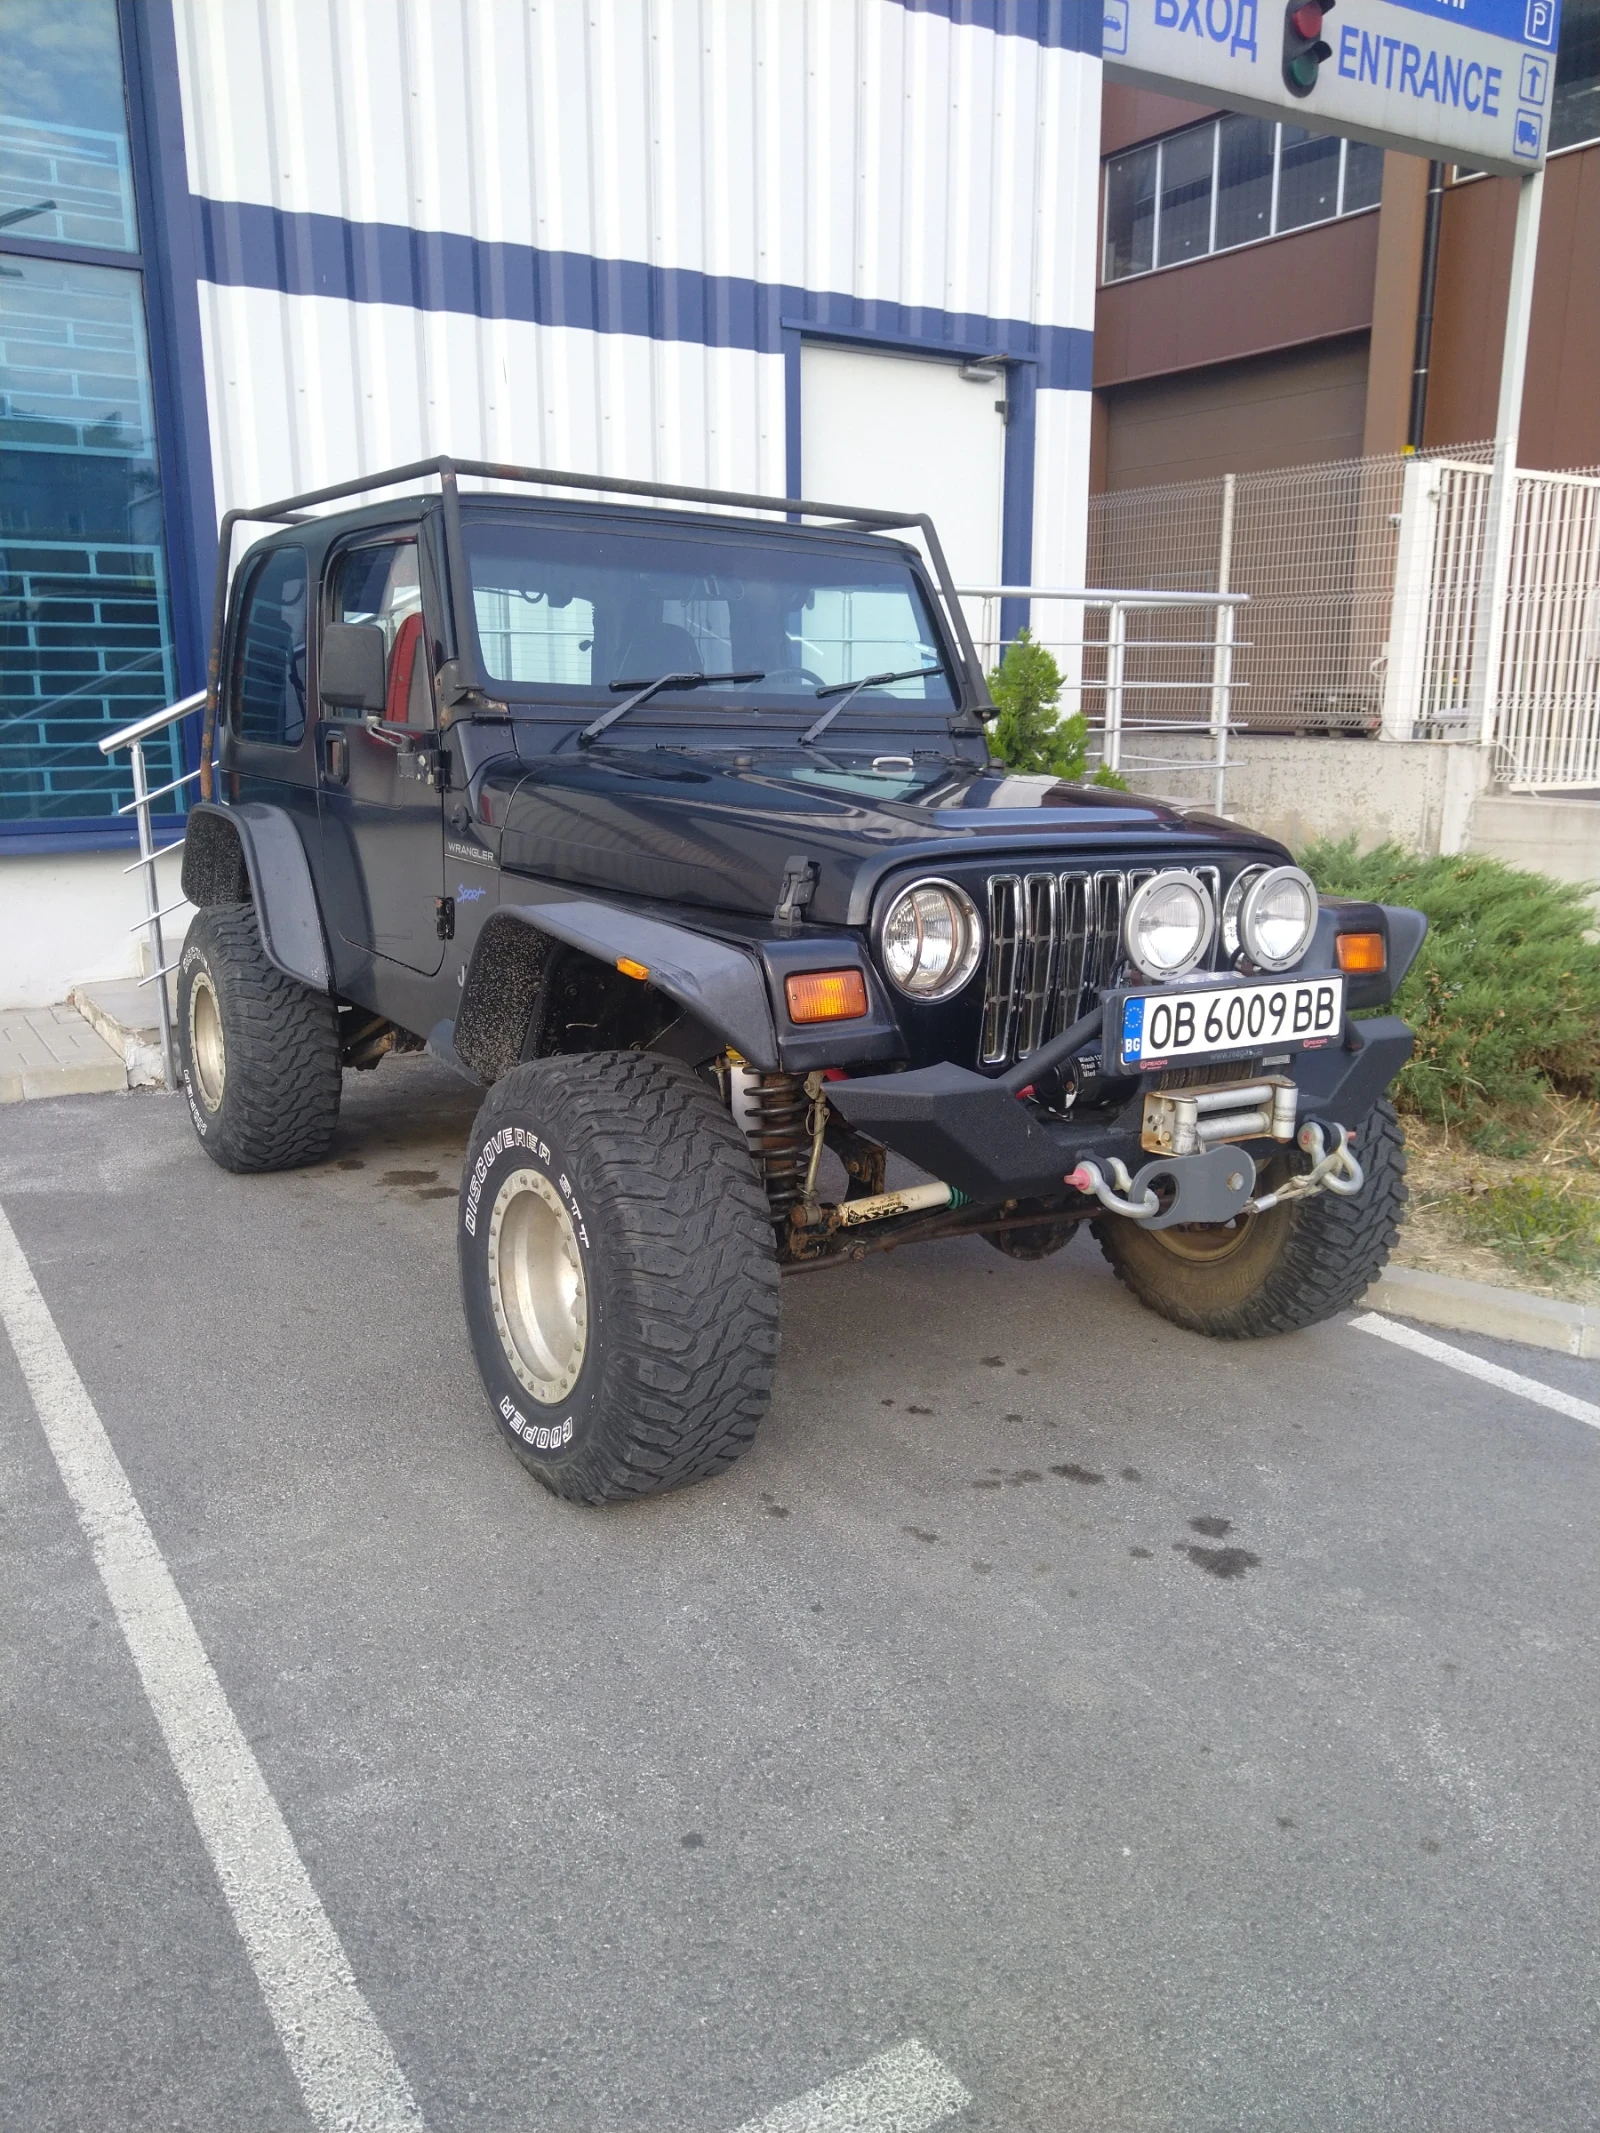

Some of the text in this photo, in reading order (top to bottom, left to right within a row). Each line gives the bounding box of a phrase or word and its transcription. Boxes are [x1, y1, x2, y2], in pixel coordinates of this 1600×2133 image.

[1338, 24, 1502, 117] ENTRANCE
[448, 842, 494, 861] WRANGLER
[1125, 1038, 1141, 1053] BG
[1150, 986, 1334, 1050] OB 6009 BB
[465, 1127, 589, 1249] DISCOVERER STT
[499, 1395, 573, 1449] COOPER
